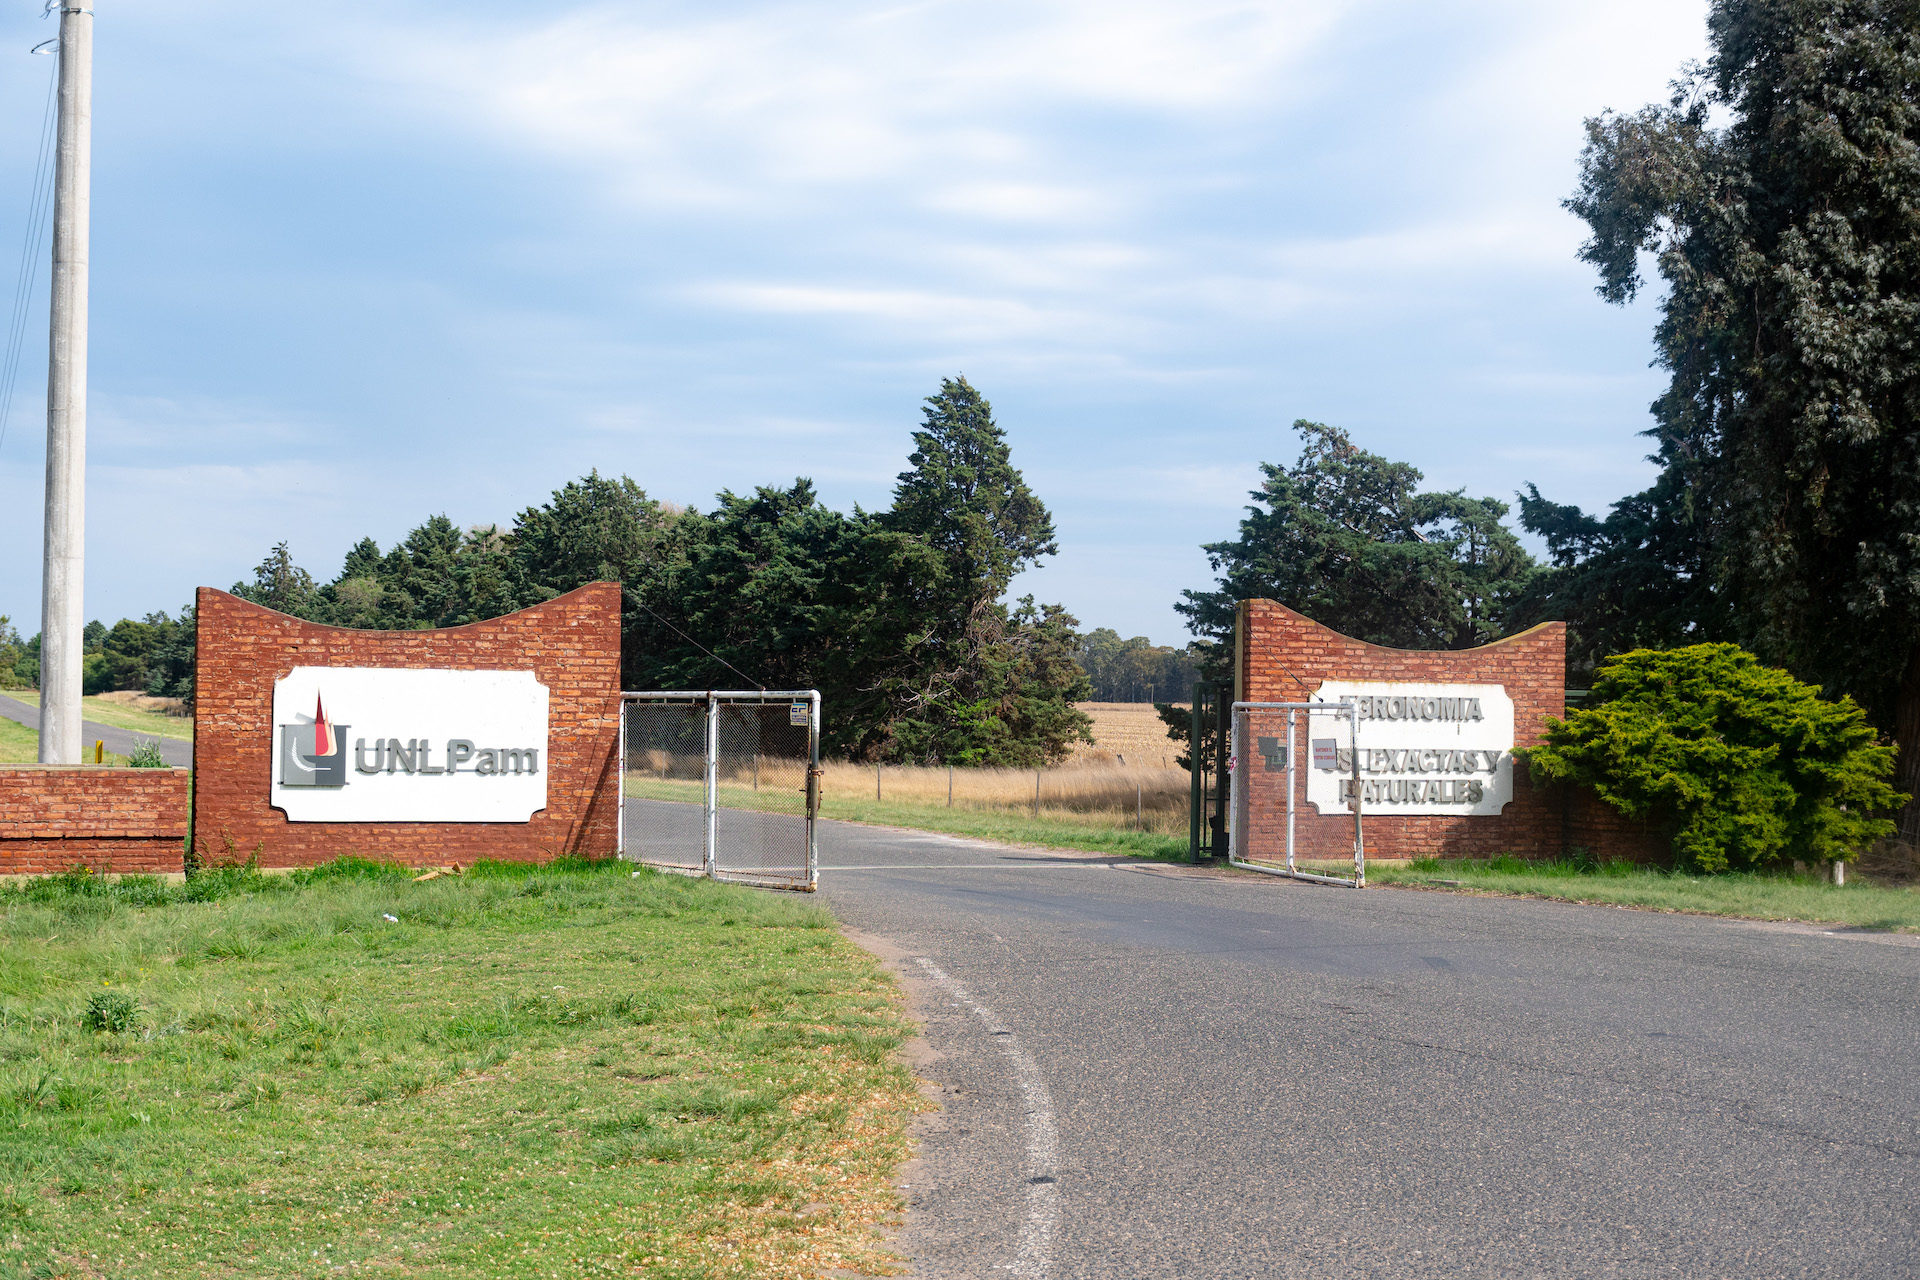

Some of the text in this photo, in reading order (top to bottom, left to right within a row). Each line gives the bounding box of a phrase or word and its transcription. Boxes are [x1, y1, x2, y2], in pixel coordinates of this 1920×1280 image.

[355, 738, 538, 775] UNLPam
[1366, 749, 1479, 774] EXACTAS
[1483, 750, 1502, 773] Y
